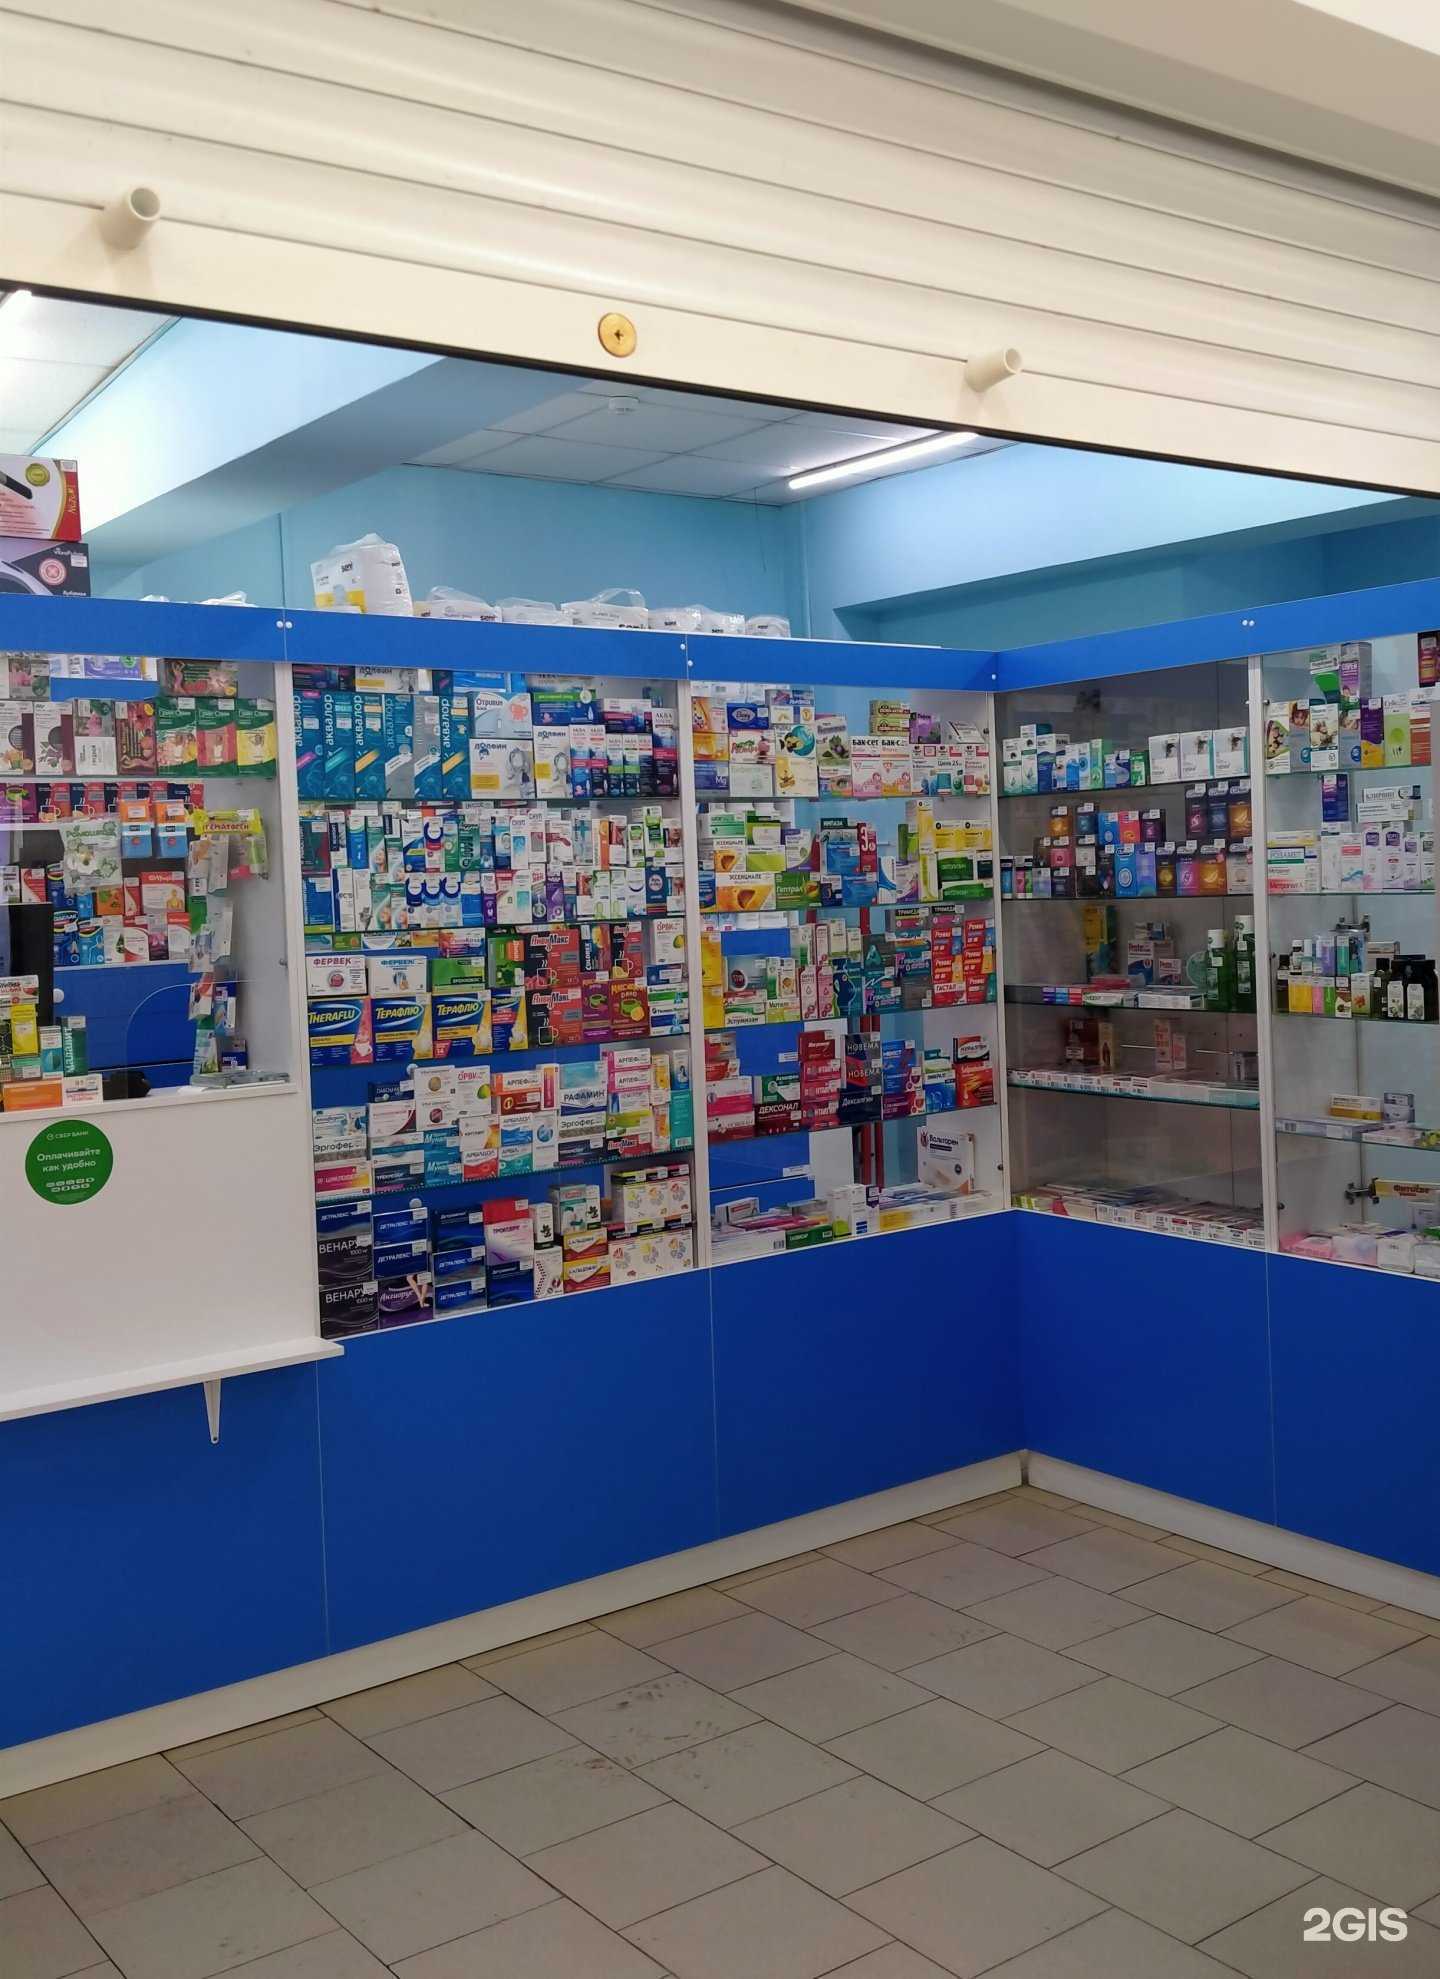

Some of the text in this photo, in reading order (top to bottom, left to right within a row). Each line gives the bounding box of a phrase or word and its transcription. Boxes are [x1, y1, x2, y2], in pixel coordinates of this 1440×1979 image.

[324, 694, 335, 746] аквалор
[353, 695, 365, 746] аквалор
[441, 698, 452, 748] аквалор
[313, 958, 353, 966] ФЕРВЕК
[308, 1009, 355, 1024] THERAFLU
[376, 1006, 419, 1020] ТЕРАФЛЮ
[437, 1003, 479, 1016] ТЕРАФЛЮ
[563, 1090, 605, 1103] РАФАМИН
[313, 1141, 354, 1152] Эргофер
[36, 1147, 101, 1162] Оплачивайте
[42, 1159, 97, 1173] как удобно
[319, 1239, 360, 1254] ВЕНАРУ
